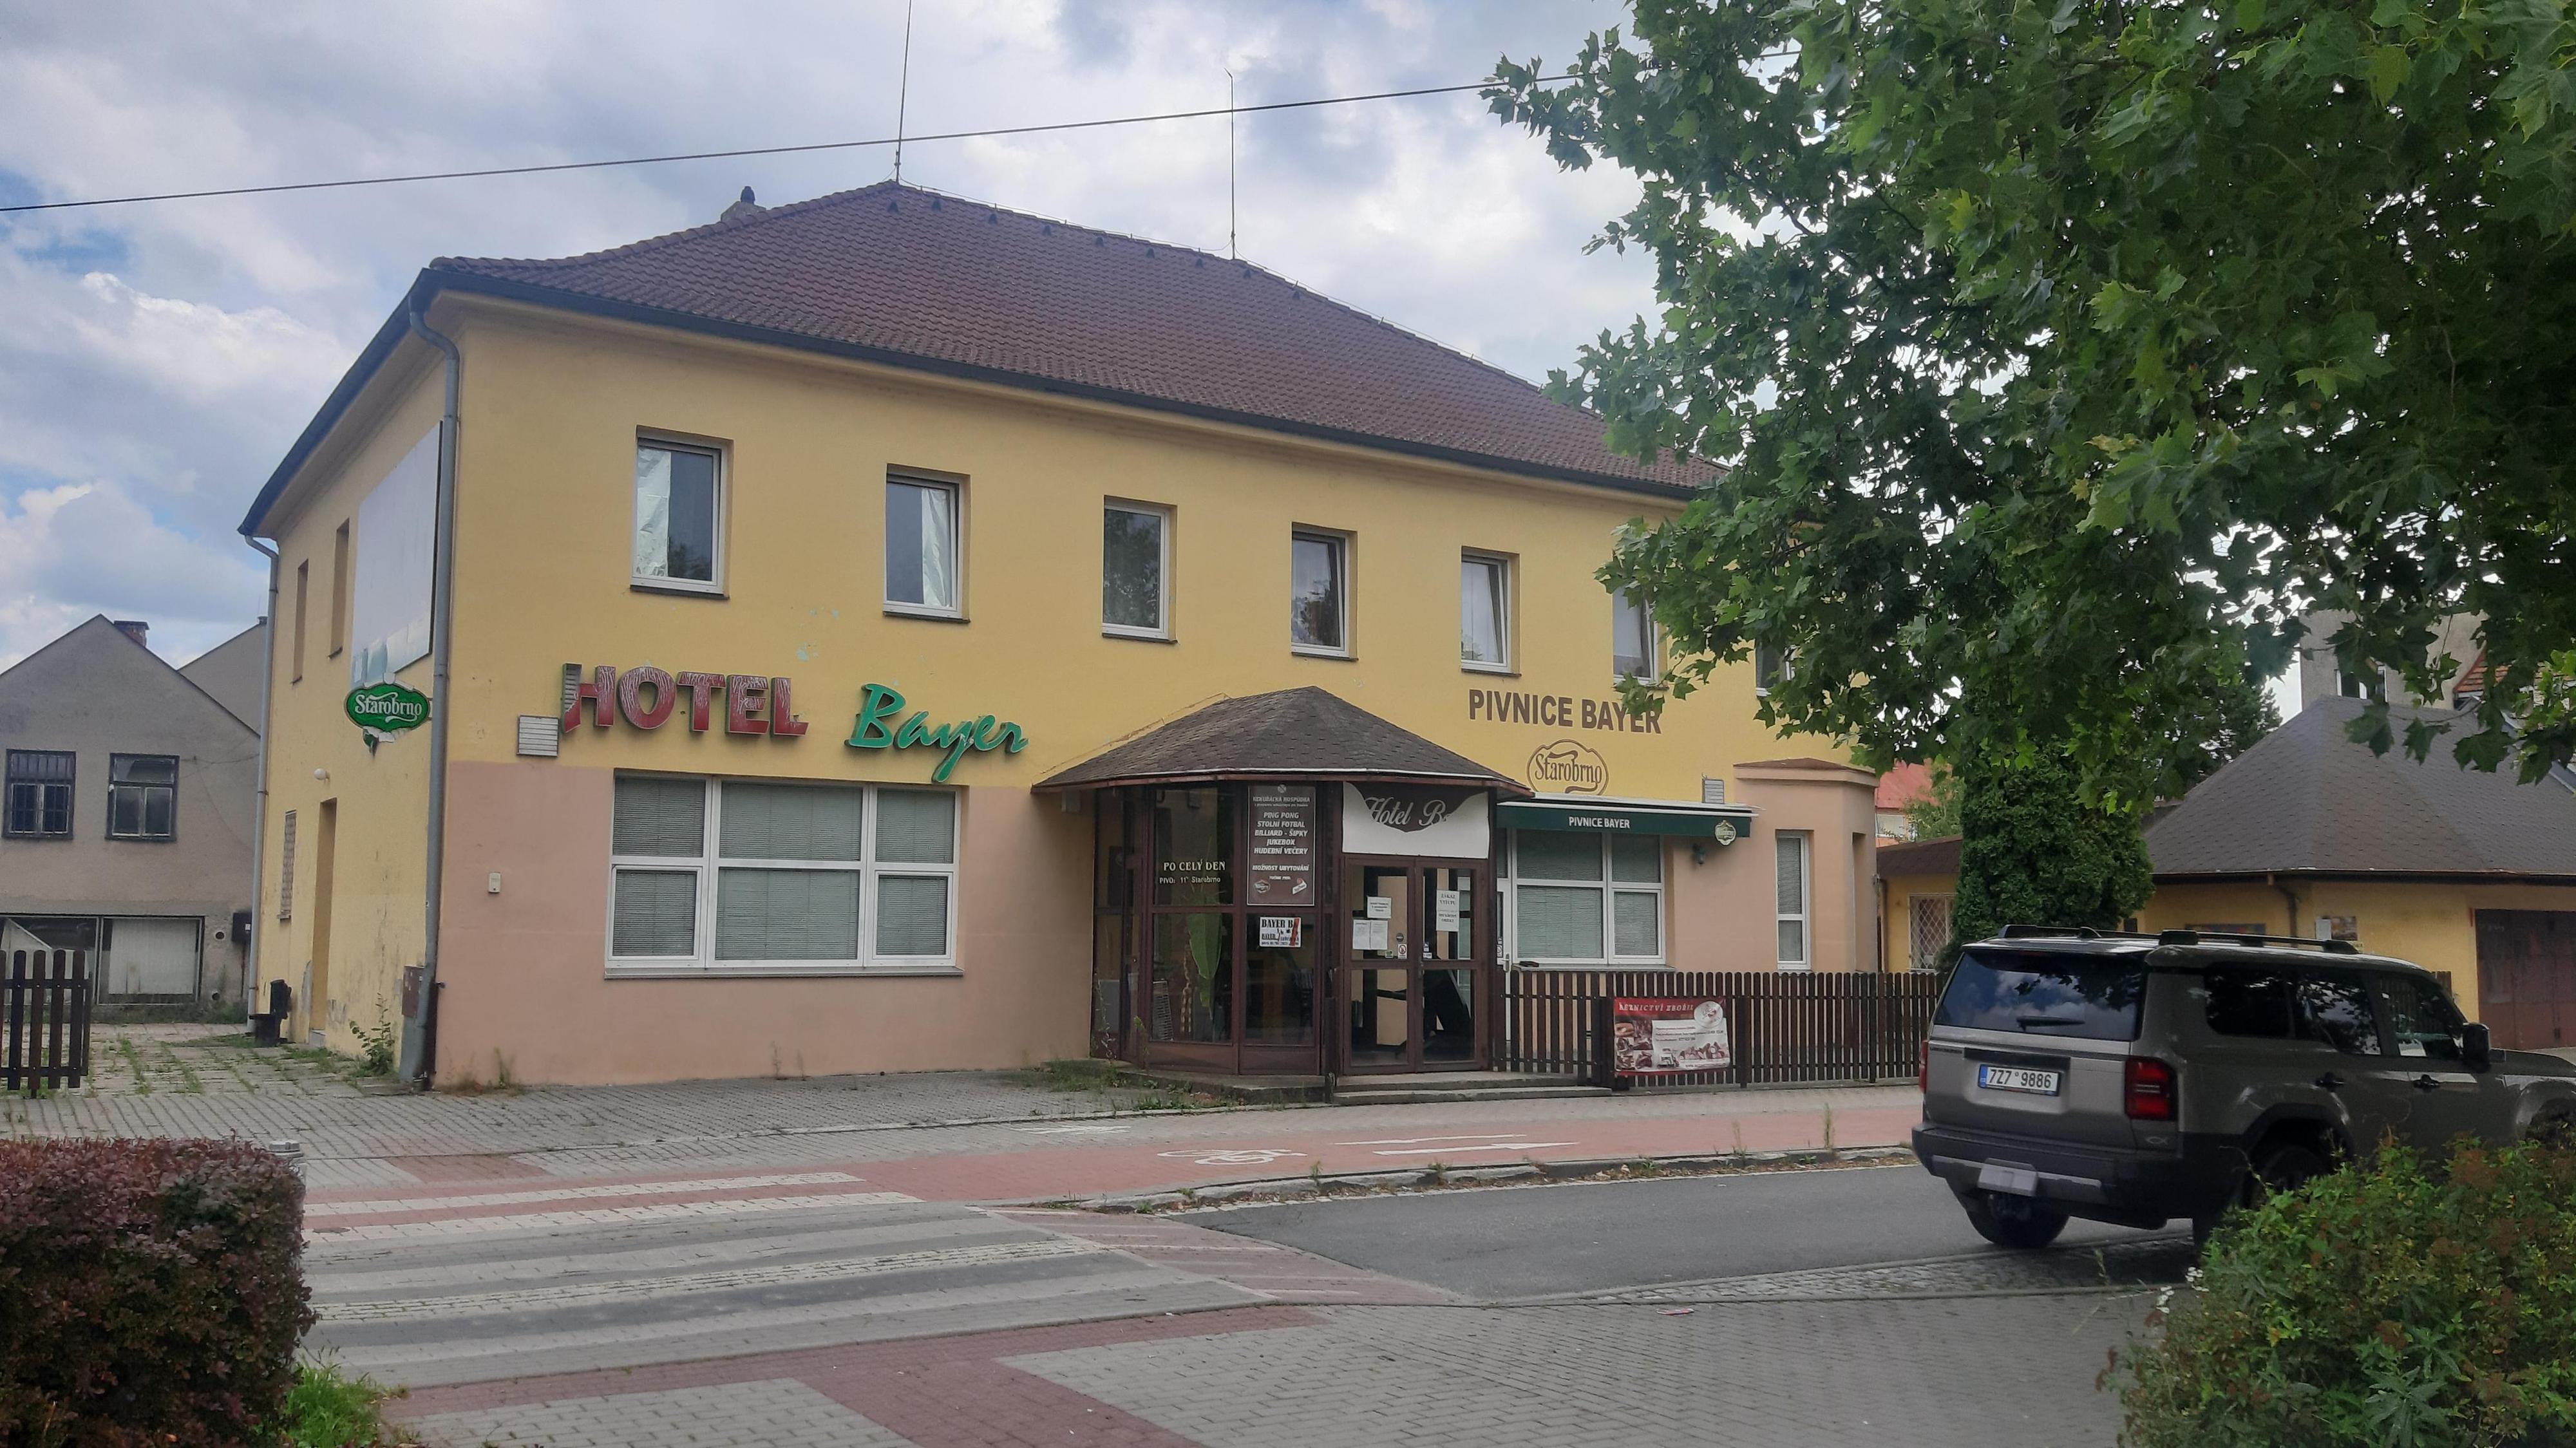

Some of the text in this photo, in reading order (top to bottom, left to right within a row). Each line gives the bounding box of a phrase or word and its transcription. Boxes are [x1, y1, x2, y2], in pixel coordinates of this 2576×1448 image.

[354, 691, 423, 722] Starobrno
[562, 663, 810, 737] HOTEL
[1469, 689, 1662, 735] PIVNICE BAYER
[844, 683, 1029, 784] Bayer
[1534, 749, 1603, 794] Starobrno
[1365, 796, 1414, 825] Hotel
[1568, 816, 1631, 829] PIVNICE BAYER
[1289, 829, 1309, 837] ŠIPKY
[1284, 847, 1309, 855] VEČERY
[1164, 859, 1226, 871] PO CELÝ DEN
[1262, 919, 1285, 928] BAYER
[1989, 1069, 2052, 1088] 7Z7 9886
